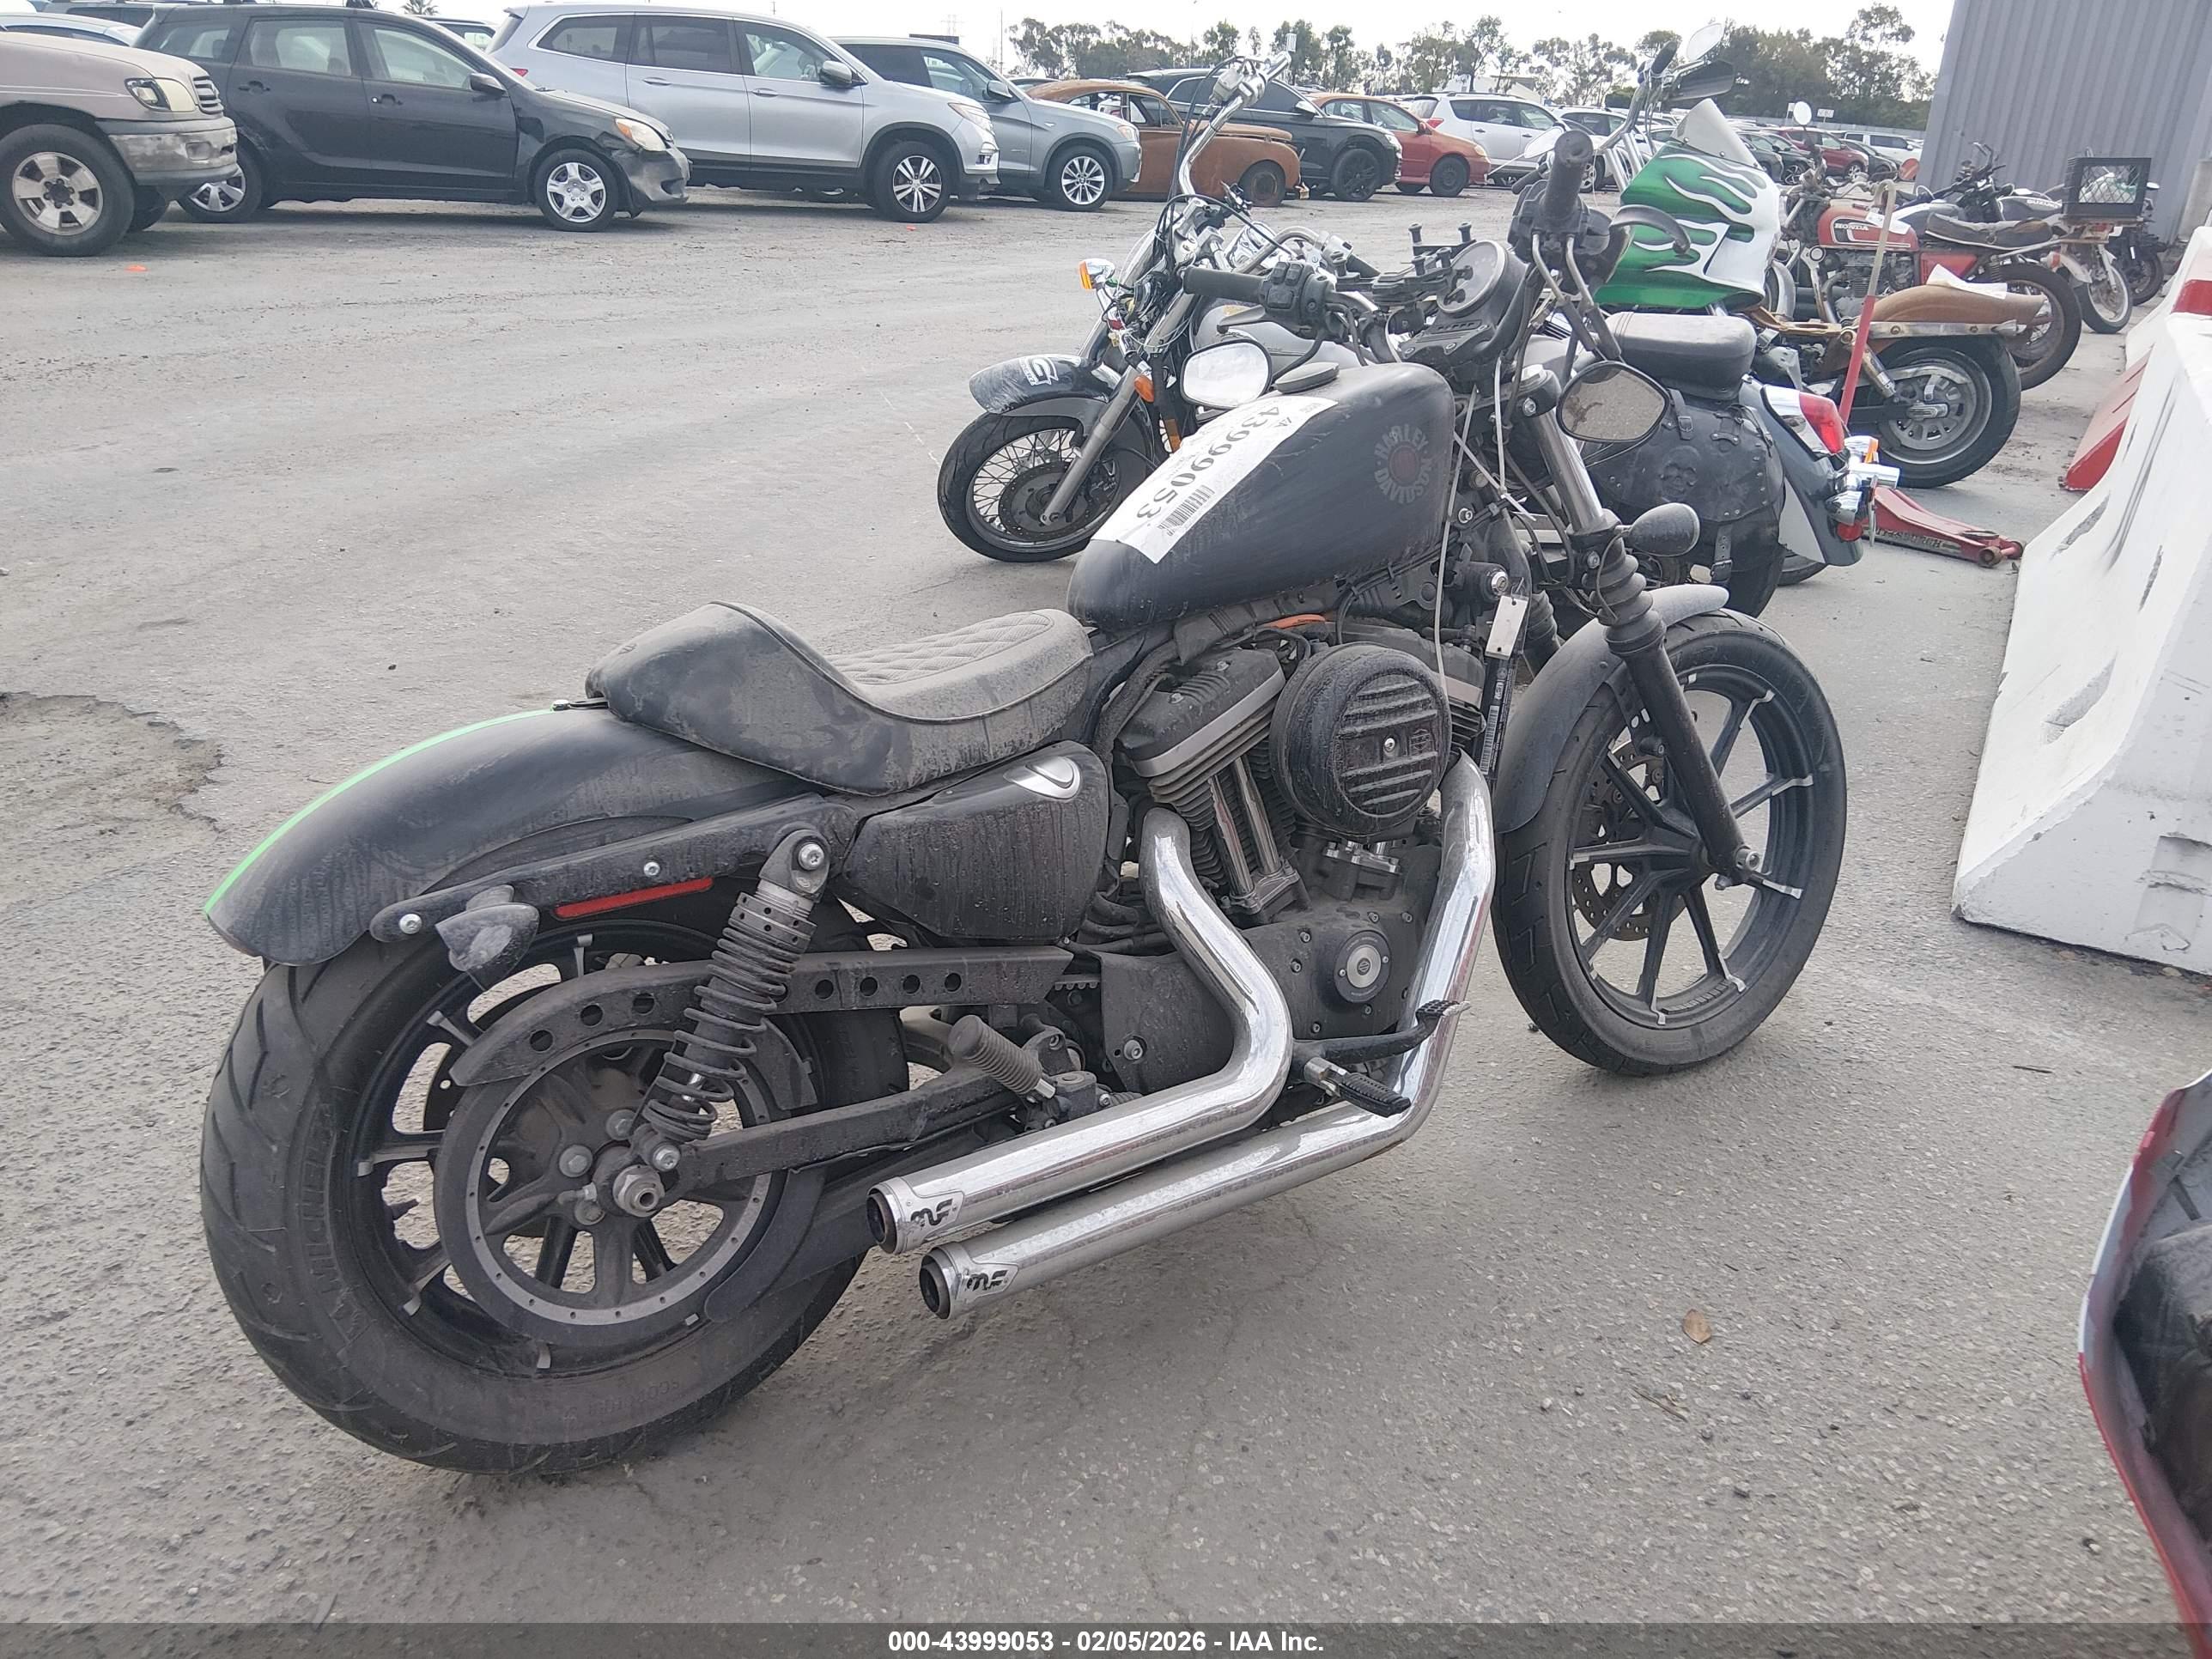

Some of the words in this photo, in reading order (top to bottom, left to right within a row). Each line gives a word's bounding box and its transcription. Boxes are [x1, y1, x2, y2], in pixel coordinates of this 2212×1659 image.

[1834, 222, 1869, 231] HONDA
[1136, 406, 1279, 518] 43999053
[1374, 423, 1430, 459] HARLEY
[1374, 457, 1434, 505] DAVIDSON
